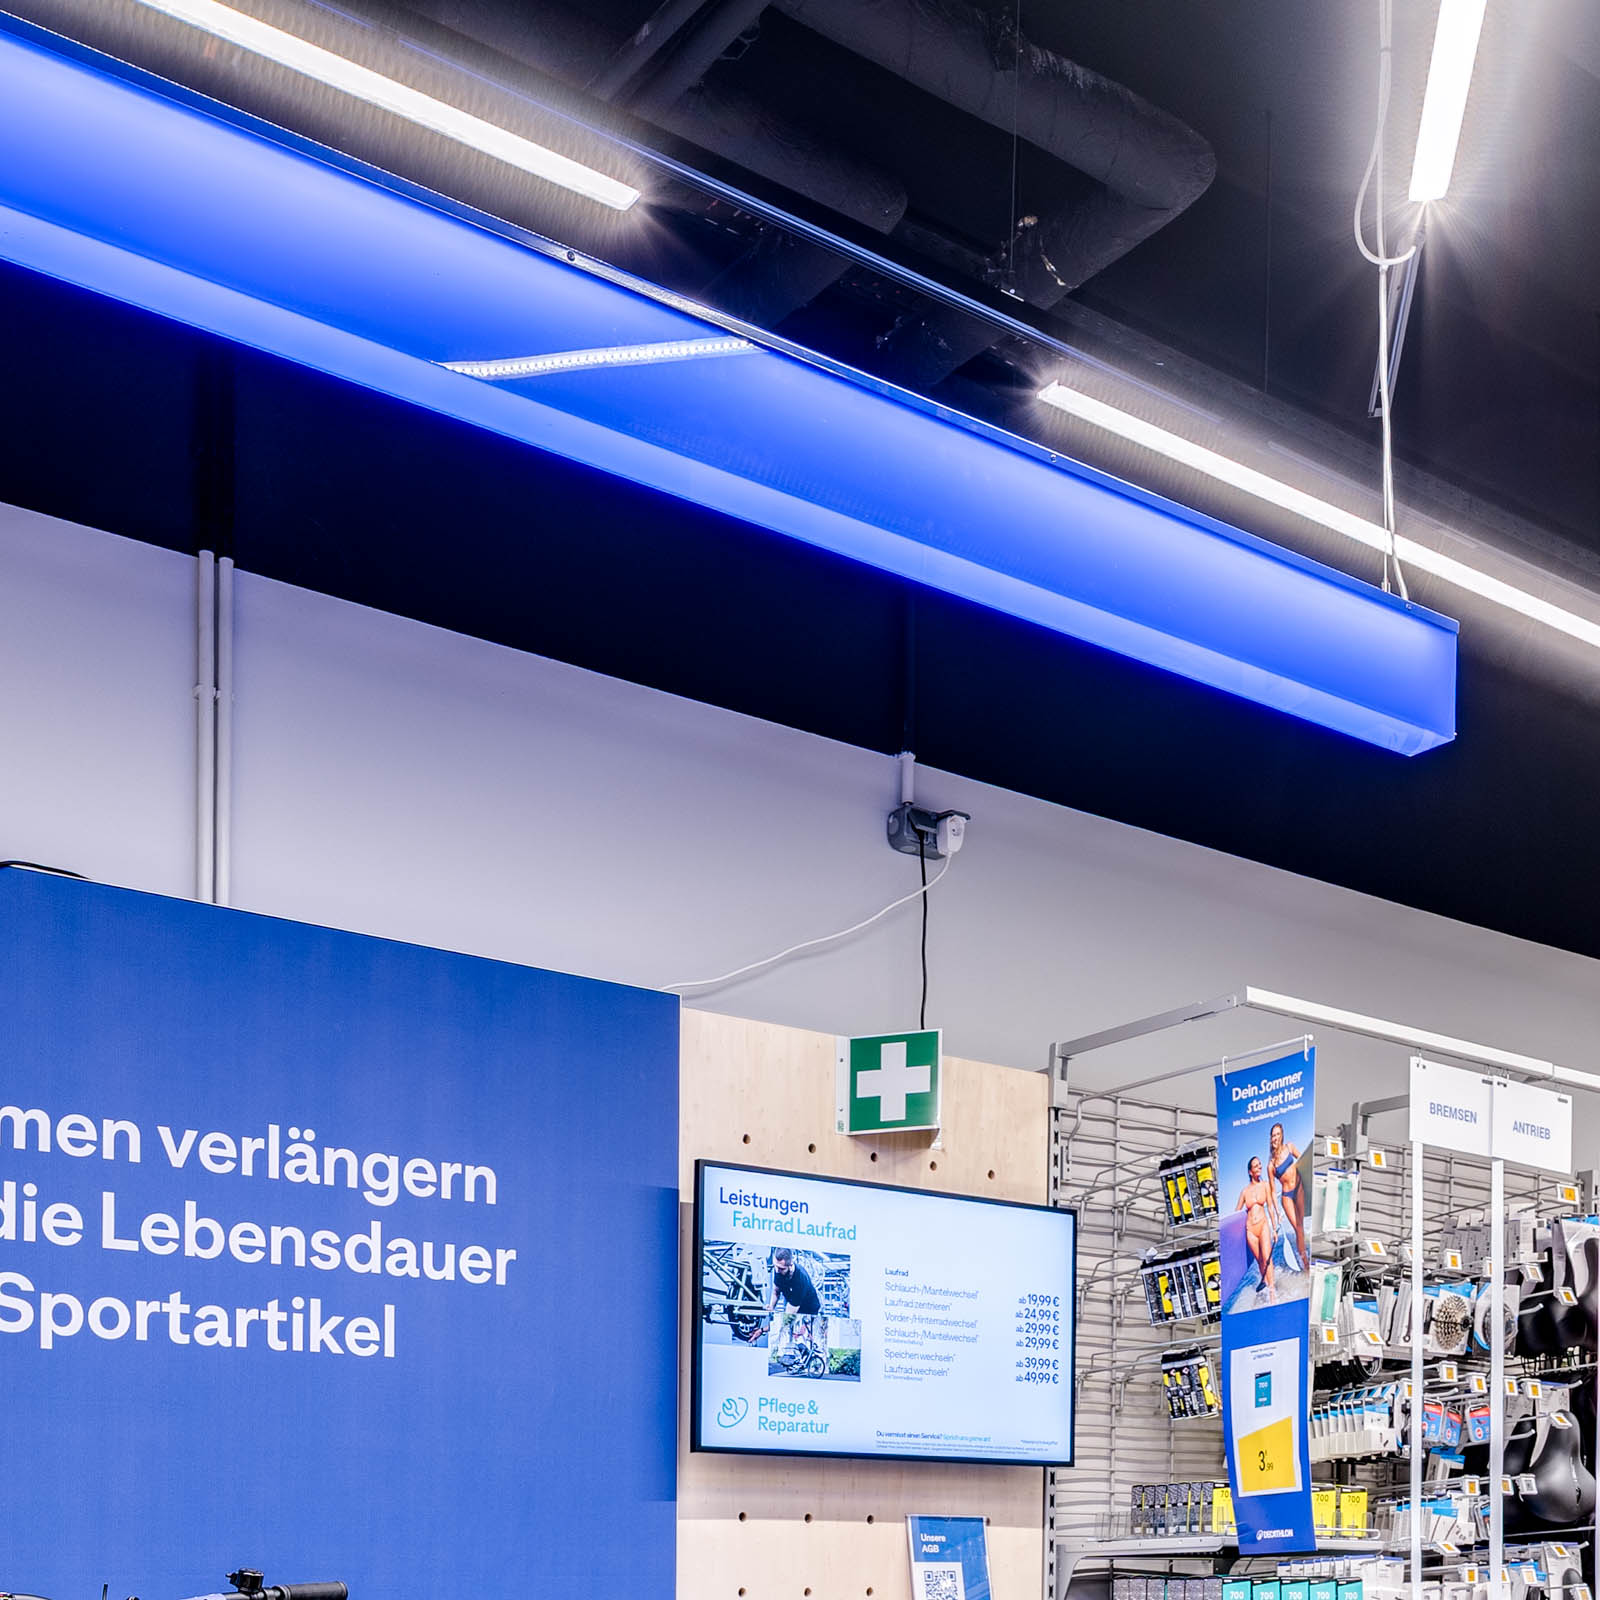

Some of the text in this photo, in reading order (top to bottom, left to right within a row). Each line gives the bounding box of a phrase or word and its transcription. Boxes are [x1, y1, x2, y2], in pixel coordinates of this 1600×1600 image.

[1232, 1071, 1303, 1102] Dein Sommer
[1246, 1086, 1304, 1114] startet hier
[1429, 1102, 1477, 1124] BREMSEN
[1513, 1120, 1551, 1140] ANTRIEB
[158, 1125, 498, 1208] verlängern
[720, 1187, 809, 1216] Leistungen
[732, 1210, 857, 1241] Fahrrad Laufrad
[101, 1192, 517, 1286] Lebensdauer
[885, 1267, 909, 1277] Laufrad
[1028, 1294, 1051, 1307] 19,99
[1053, 1296, 1060, 1307] €
[1024, 1307, 1051, 1322] 24,99
[1053, 1310, 1060, 1322] €
[1024, 1322, 1051, 1336] 29,99
[1052, 1325, 1060, 1336] €
[1025, 1336, 1051, 1351] 29,99
[1052, 1339, 1060, 1350] €
[1024, 1357, 1051, 1372] 39,99
[1052, 1359, 1060, 1370] €
[1024, 1371, 1051, 1385] 49,99
[1052, 1373, 1059, 1384] €
[758, 1397, 818, 1418] Pflege &
[758, 1416, 830, 1435] Reparatur
[1315, 1493, 1329, 1502] 700
[1347, 1495, 1361, 1504] 700
[920, 1533, 946, 1543] Unsere
[922, 1544, 940, 1553] AGB
[1229, 1591, 1245, 1600] 700
[1259, 1591, 1274, 1600] 700
[1288, 1591, 1303, 1600] 700
[1316, 1591, 1330, 1600] 700
[1344, 1592, 1358, 1600] 700
